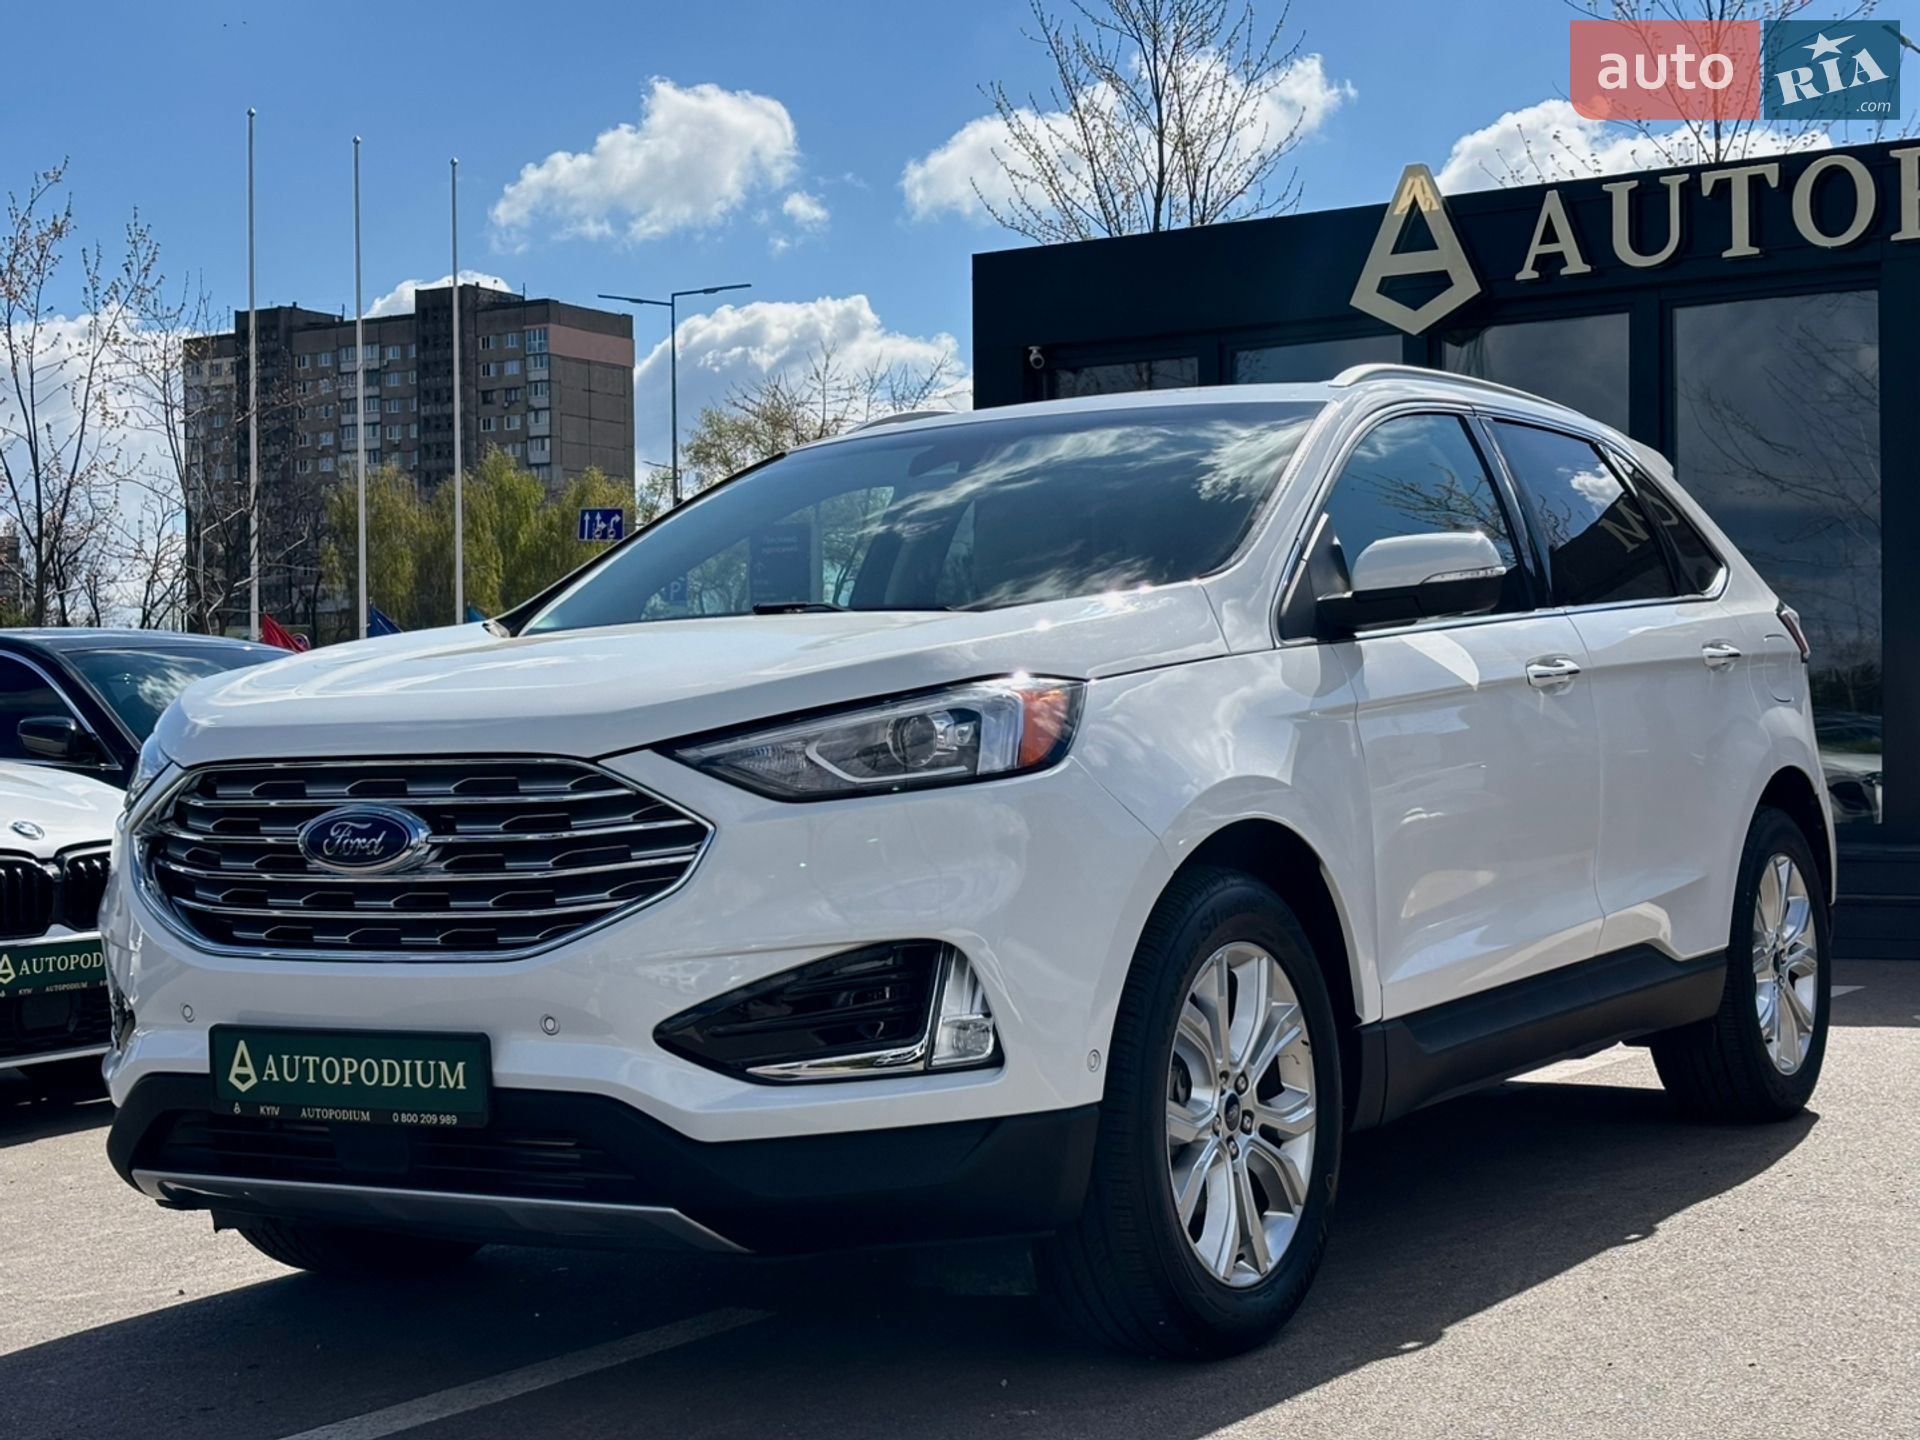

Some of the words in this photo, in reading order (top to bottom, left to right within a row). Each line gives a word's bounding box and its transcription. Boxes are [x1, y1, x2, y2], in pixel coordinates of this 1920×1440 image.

[323, 821, 387, 856] Ford
[263, 1054, 466, 1089] AUTOPODIUM
[260, 1105, 280, 1116] KYIV
[301, 1107, 370, 1122] AUTOPODIUM
